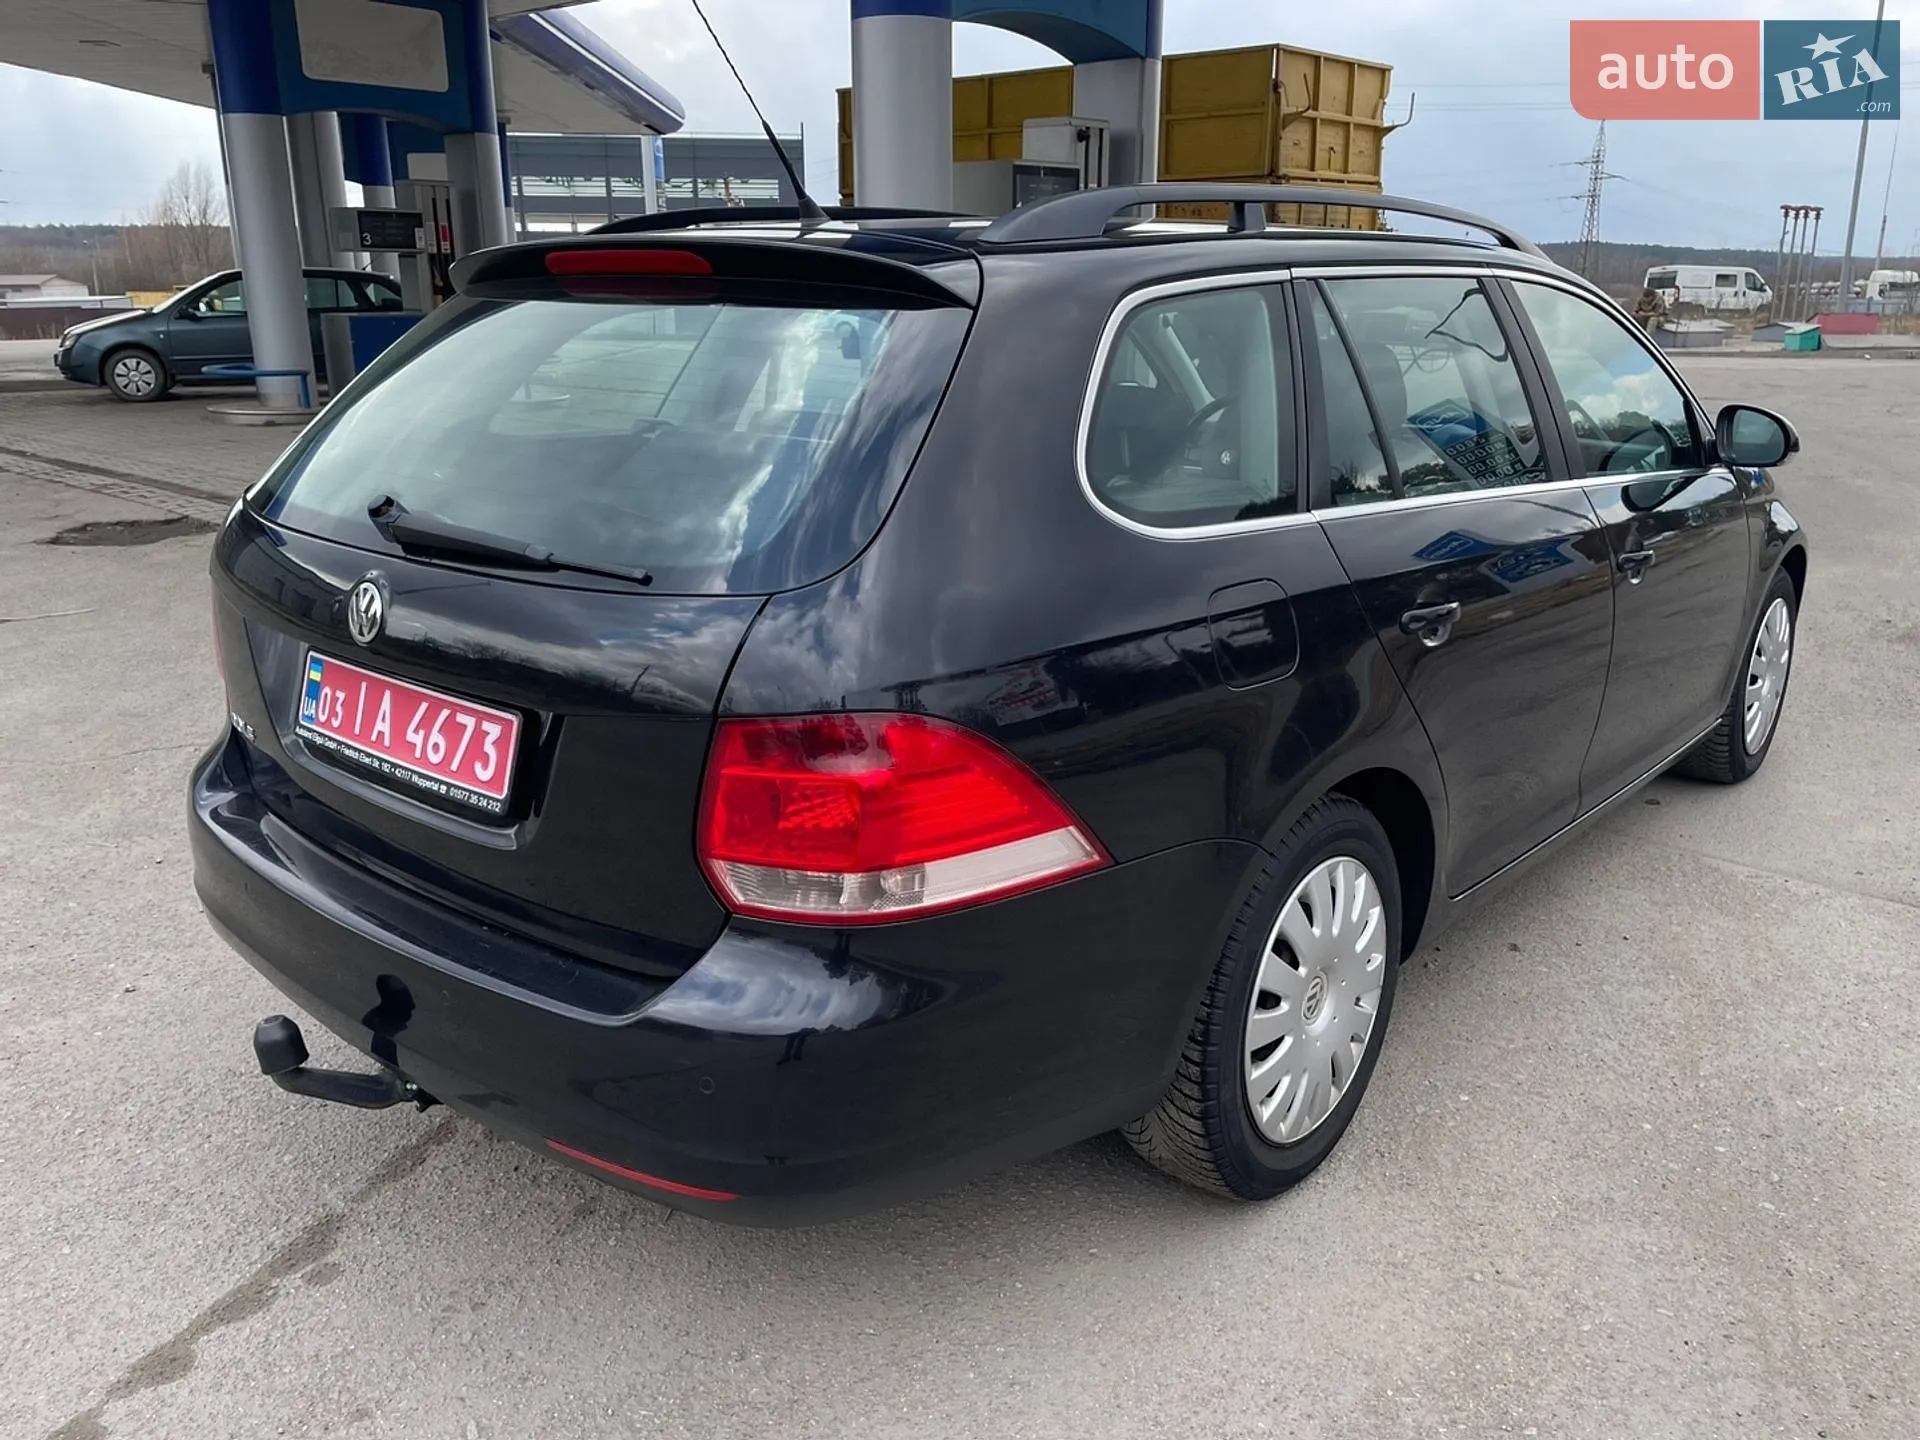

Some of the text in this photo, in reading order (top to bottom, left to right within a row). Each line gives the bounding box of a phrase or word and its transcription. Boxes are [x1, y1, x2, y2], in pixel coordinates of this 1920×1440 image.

[362, 232, 372, 245] 3
[303, 696, 317, 718] UA
[318, 686, 346, 729] 03
[354, 681, 391, 748] IA
[405, 701, 503, 783] 4673
